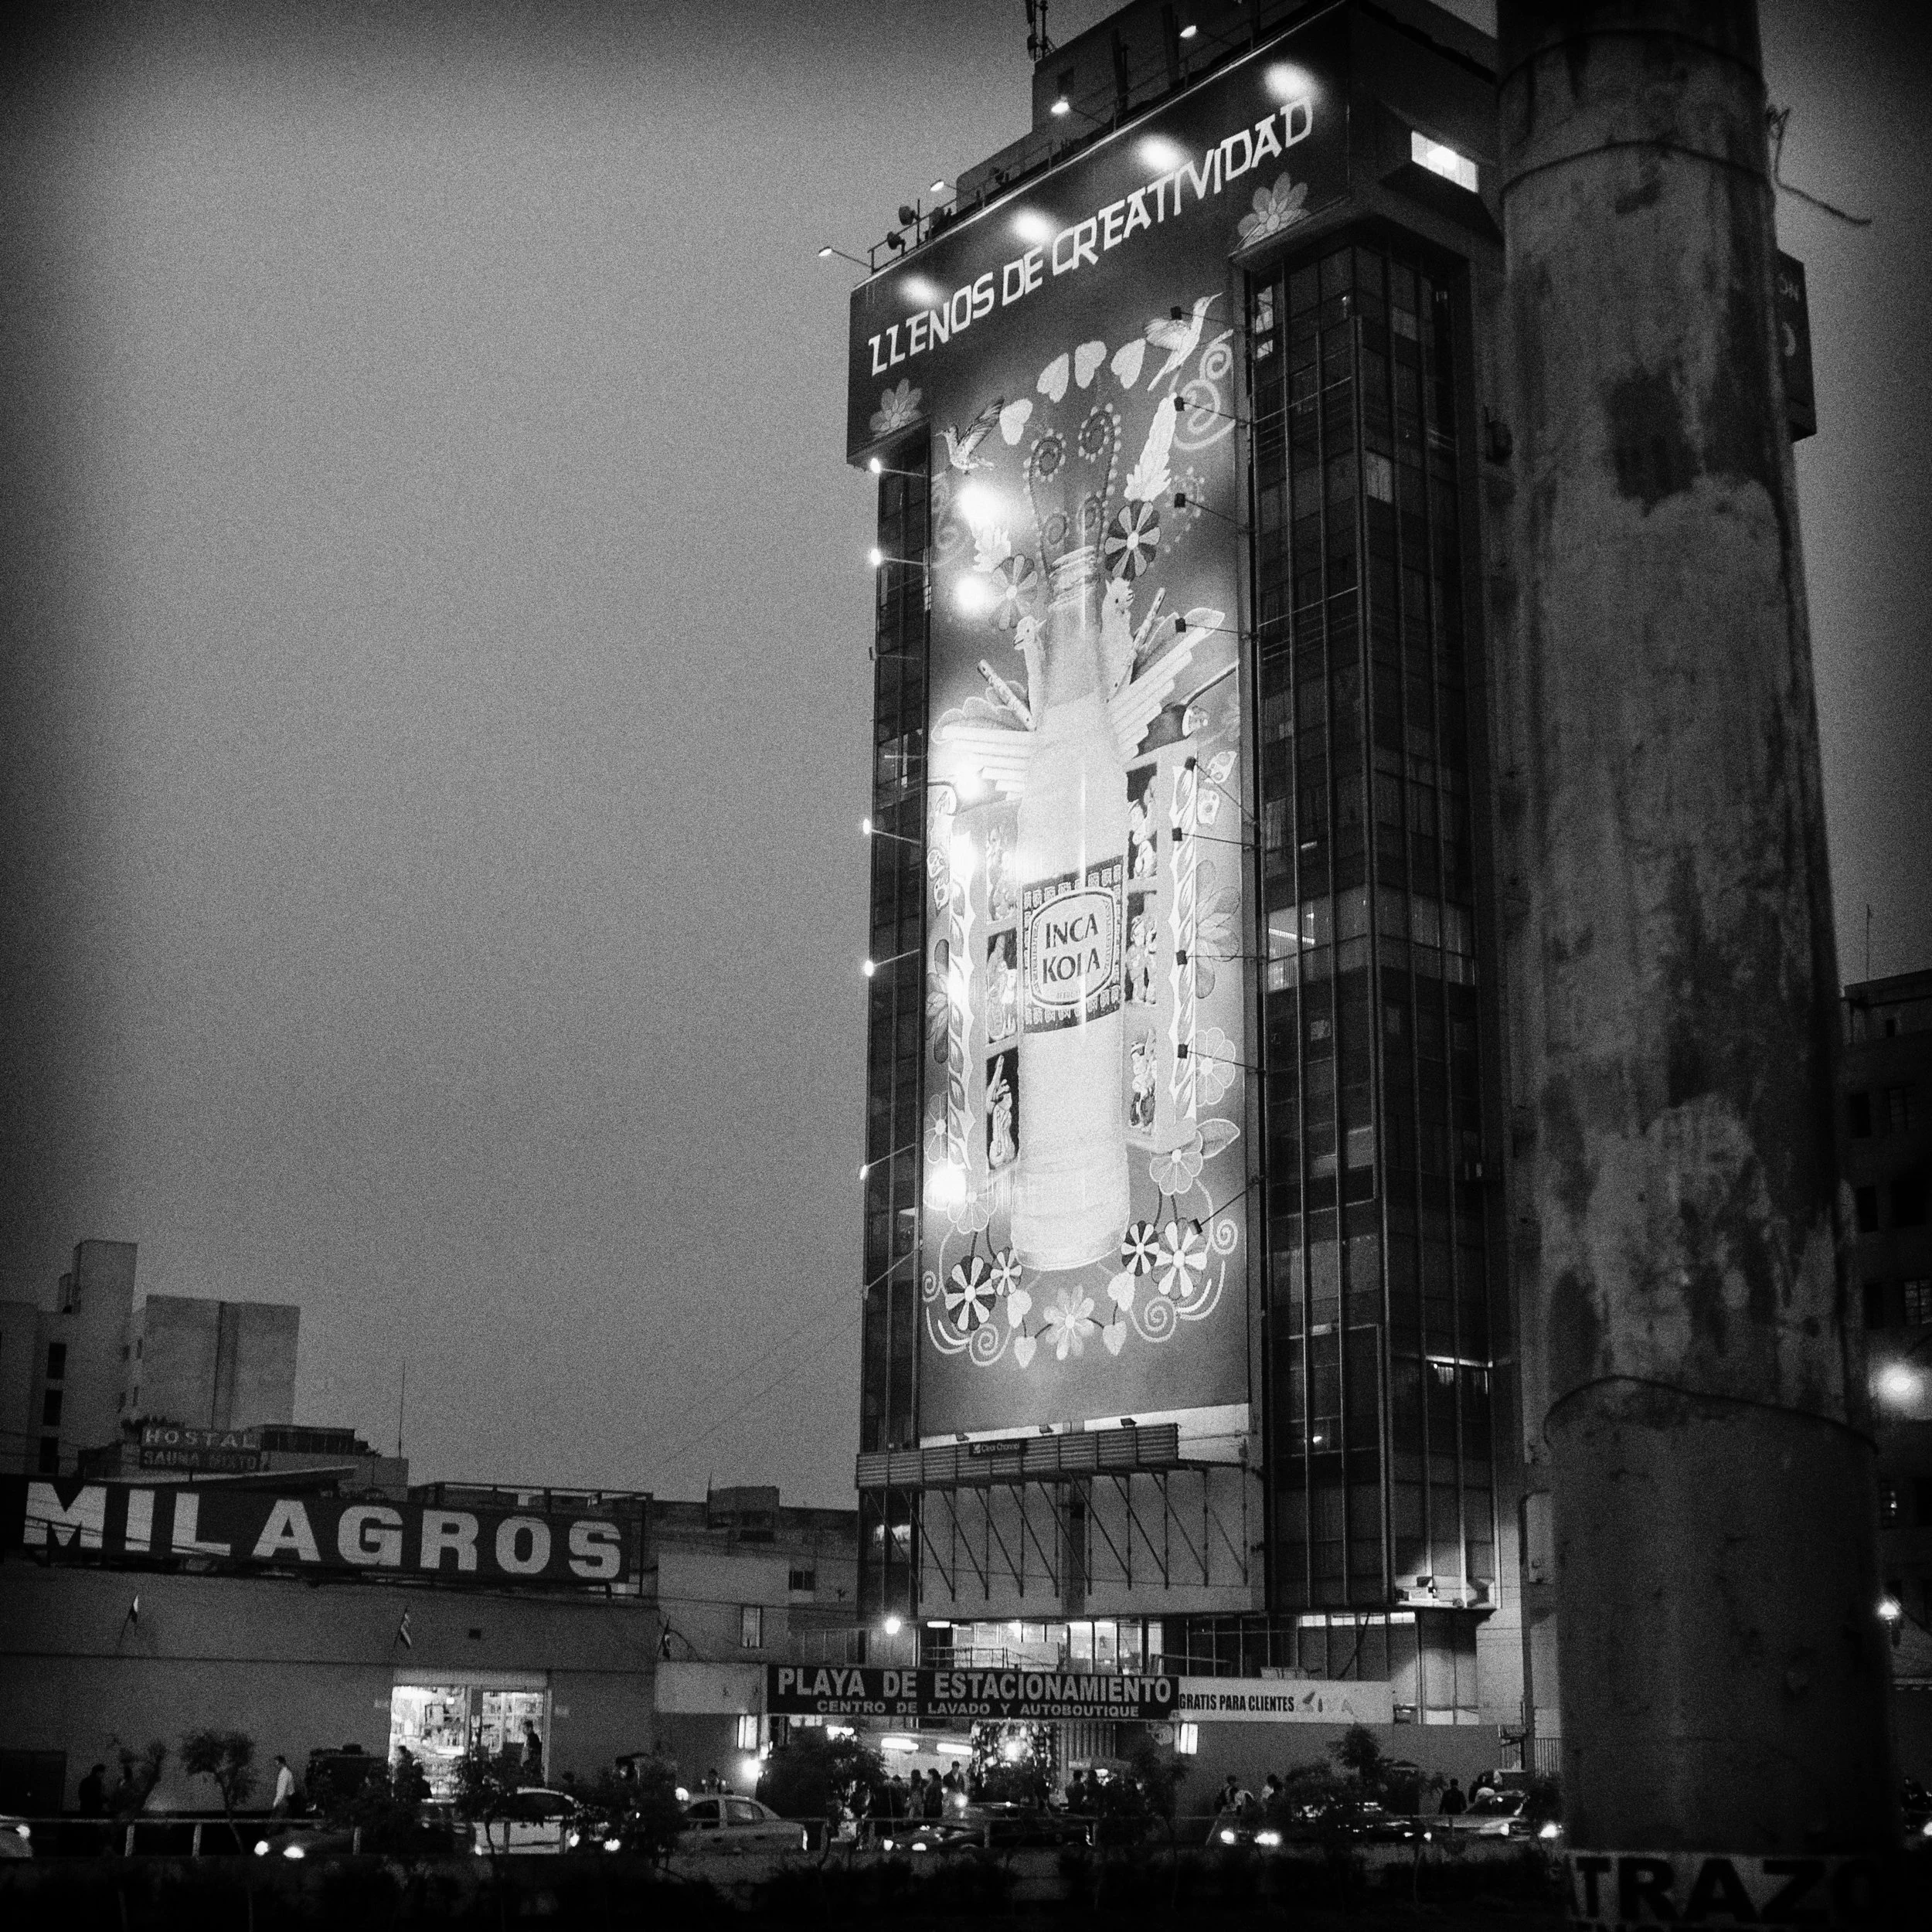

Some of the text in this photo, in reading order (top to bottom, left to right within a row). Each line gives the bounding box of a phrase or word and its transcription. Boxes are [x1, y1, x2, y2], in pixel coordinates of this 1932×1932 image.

[868, 96, 1315, 376] LLENOS DE CREATIVIDAD
[1046, 913, 1098, 949] INCA
[1043, 947, 1100, 984] KOLA
[145, 1429, 257, 1449] HOSTAL
[23, 1481, 621, 1580] MILAGROS
[778, 1667, 1172, 1702] PLAYA DE ESTACIONAMIENTO
[1179, 1692, 1216, 1710] GRATIS
[1219, 1695, 1247, 1711] PARA
[1248, 1696, 1294, 1712] CLIENTES
[817, 1700, 1138, 1717] CENTRO DE LAVADO Y AUTOBOUTIQUE
